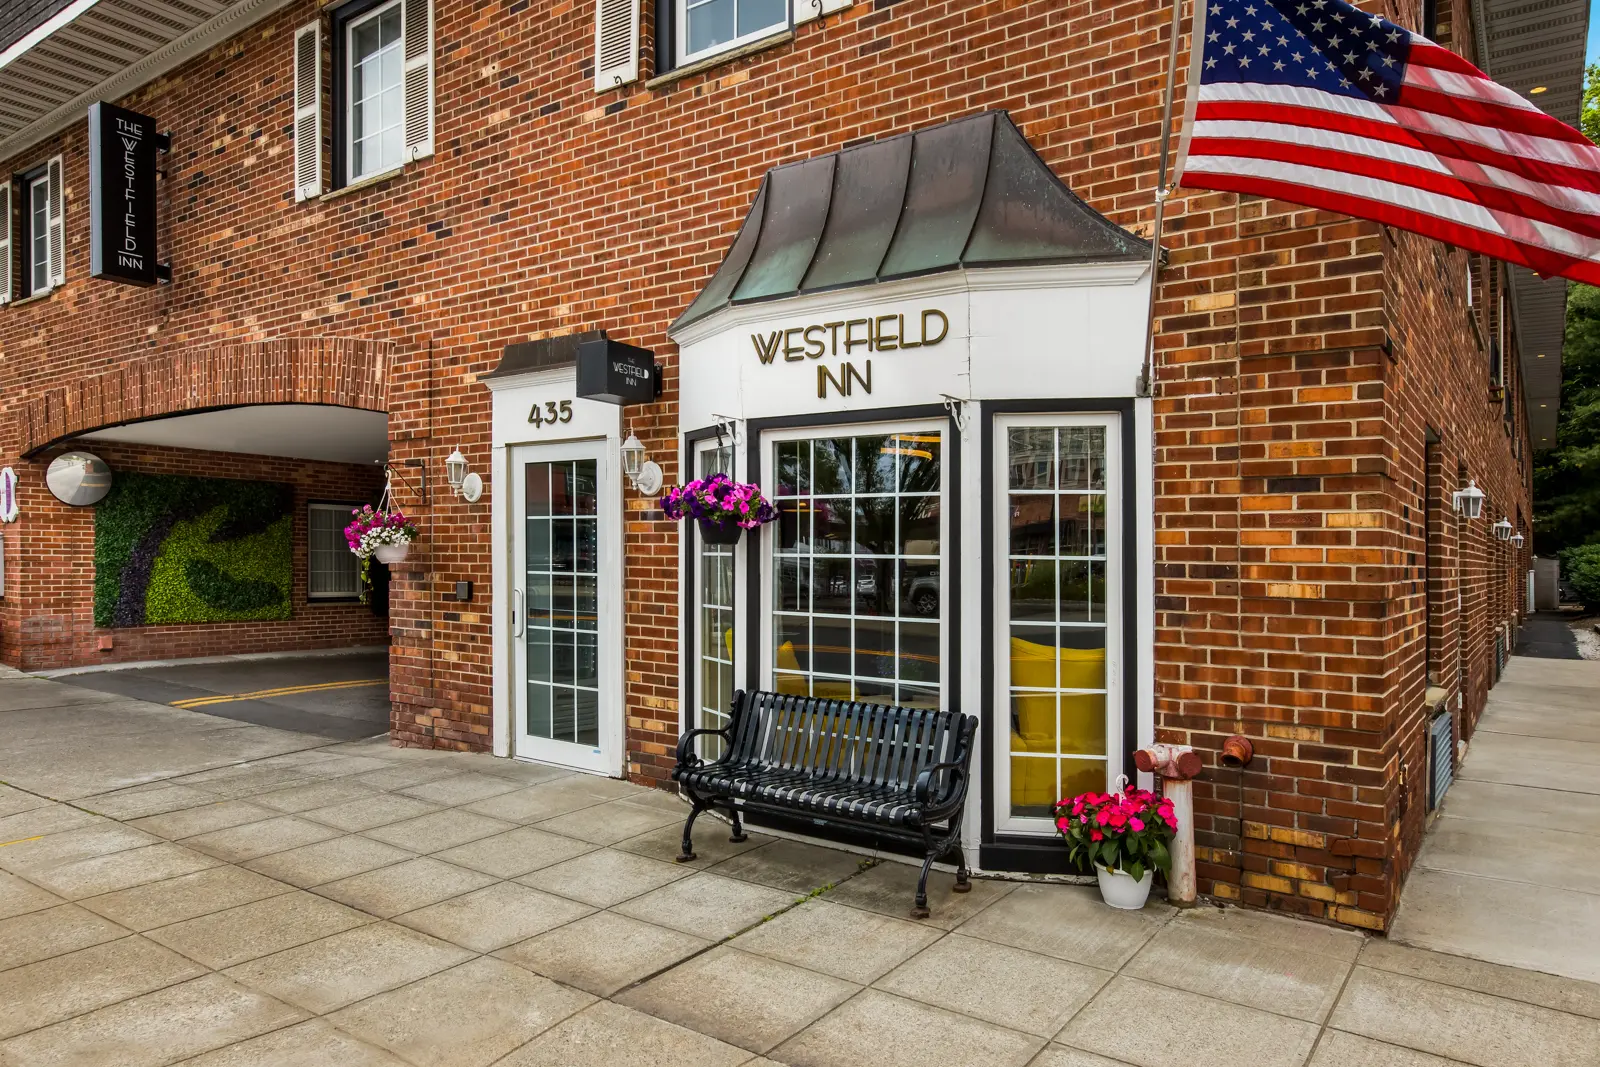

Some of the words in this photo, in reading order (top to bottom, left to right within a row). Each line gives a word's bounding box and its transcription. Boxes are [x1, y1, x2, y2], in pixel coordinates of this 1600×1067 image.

[115, 118, 142, 136] THE
[119, 137, 138, 251] WESTFIELD
[118, 255, 143, 271] INN
[751, 309, 948, 364] WESTFIELD
[612, 361, 649, 379] WESTFIELD
[817, 360, 873, 398] INN
[625, 377, 637, 387] INN
[527, 400, 573, 429] 435
